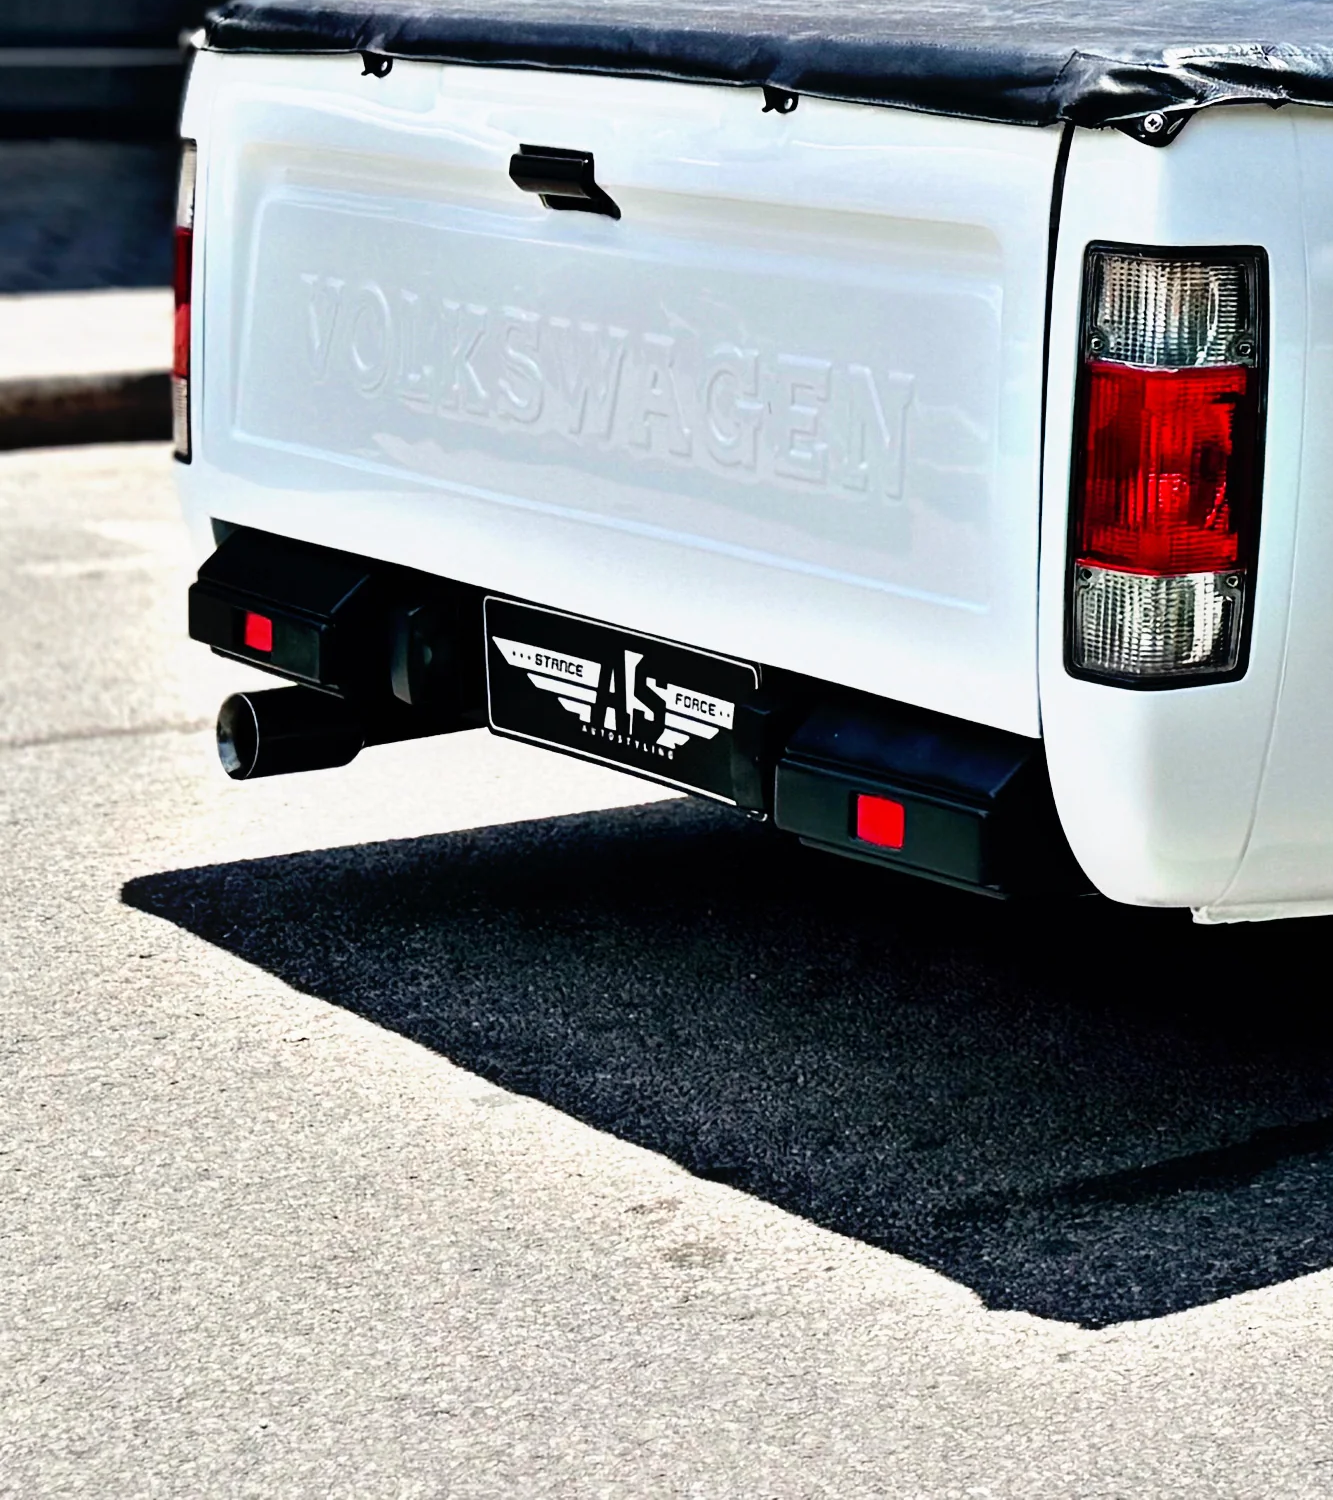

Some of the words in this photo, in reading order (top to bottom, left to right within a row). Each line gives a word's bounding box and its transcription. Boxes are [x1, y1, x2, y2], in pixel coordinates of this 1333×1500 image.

[300, 273, 916, 500] VOLKSWAGEN
[534, 653, 584, 678] STANCE
[675, 693, 717, 717] FORCE
[581, 723, 675, 760] AUTOSTYLING
